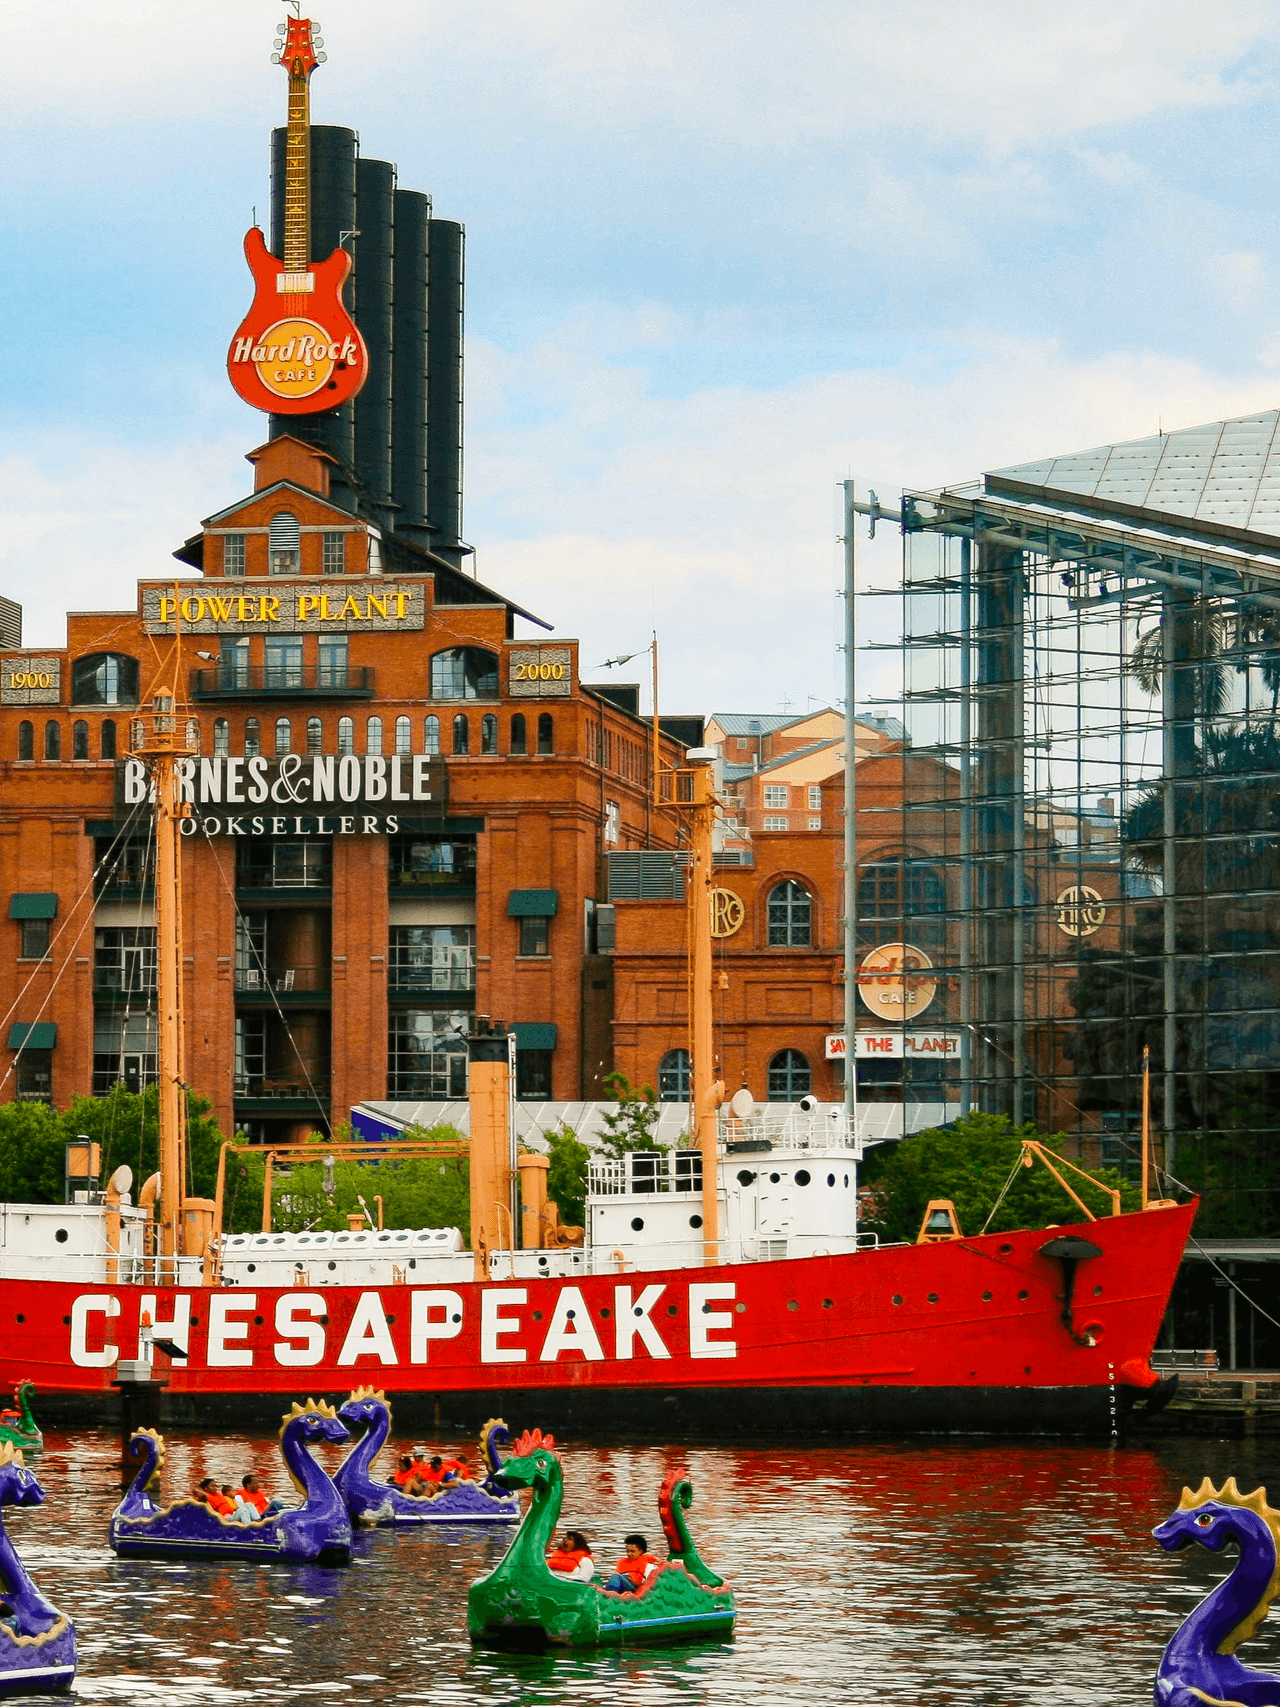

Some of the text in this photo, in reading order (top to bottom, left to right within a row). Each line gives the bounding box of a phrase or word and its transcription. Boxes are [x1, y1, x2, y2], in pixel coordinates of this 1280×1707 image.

[233, 335, 357, 367] Hard Rock
[273, 368, 317, 382] CAFE
[159, 592, 412, 623] POWER PLANT
[10, 671, 52, 689] 1900
[514, 662, 566, 680] 2000
[271, 754, 310, 804] &
[313, 755, 432, 803] NOBLE
[179, 815, 399, 836] OOKSELLERS
[864, 1037, 893, 1052] THE
[904, 1037, 958, 1053] PLANET
[70, 1282, 737, 1367] CHESAPEAKE
